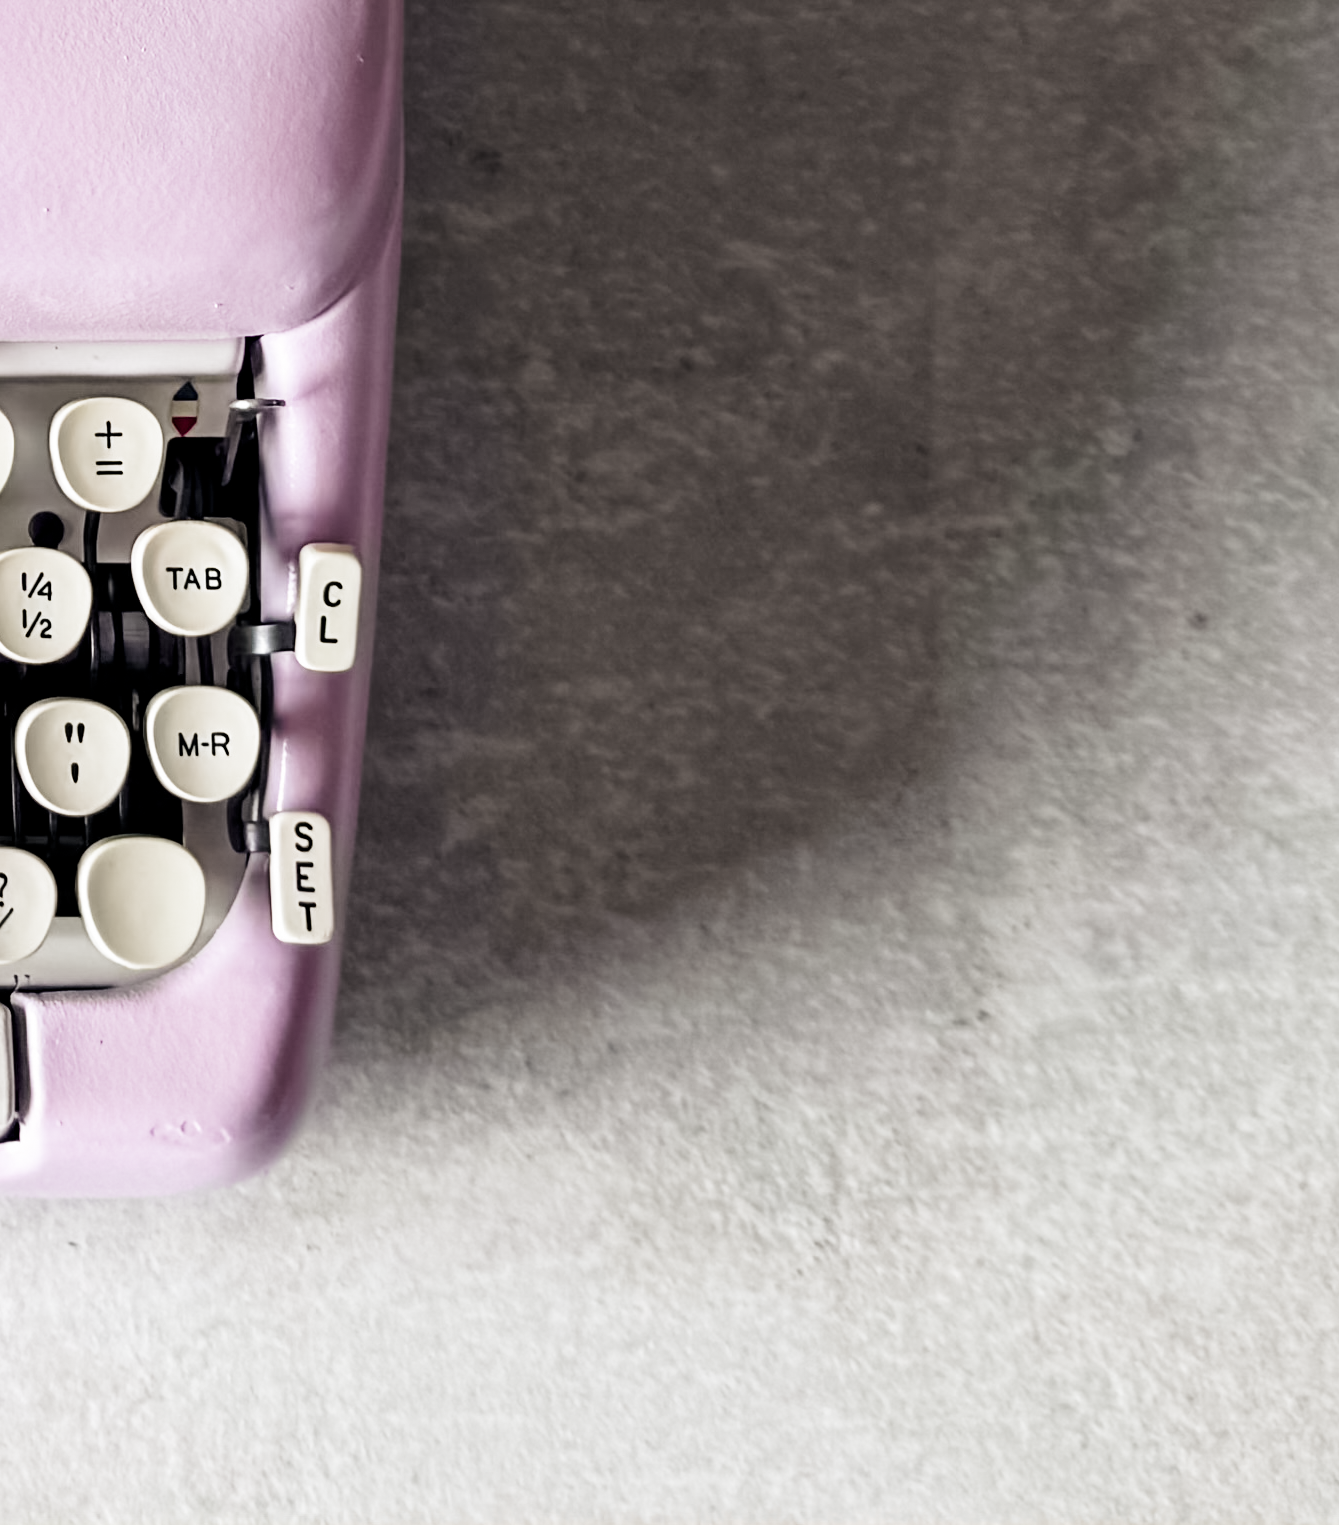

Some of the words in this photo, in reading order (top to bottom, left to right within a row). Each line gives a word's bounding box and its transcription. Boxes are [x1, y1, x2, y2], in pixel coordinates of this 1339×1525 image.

[94, 420, 123, 449] +
[95, 460, 124, 476] =
[165, 566, 222, 591] TAB
[178, 731, 230, 757] M-R
[294, 821, 317, 932] SET
